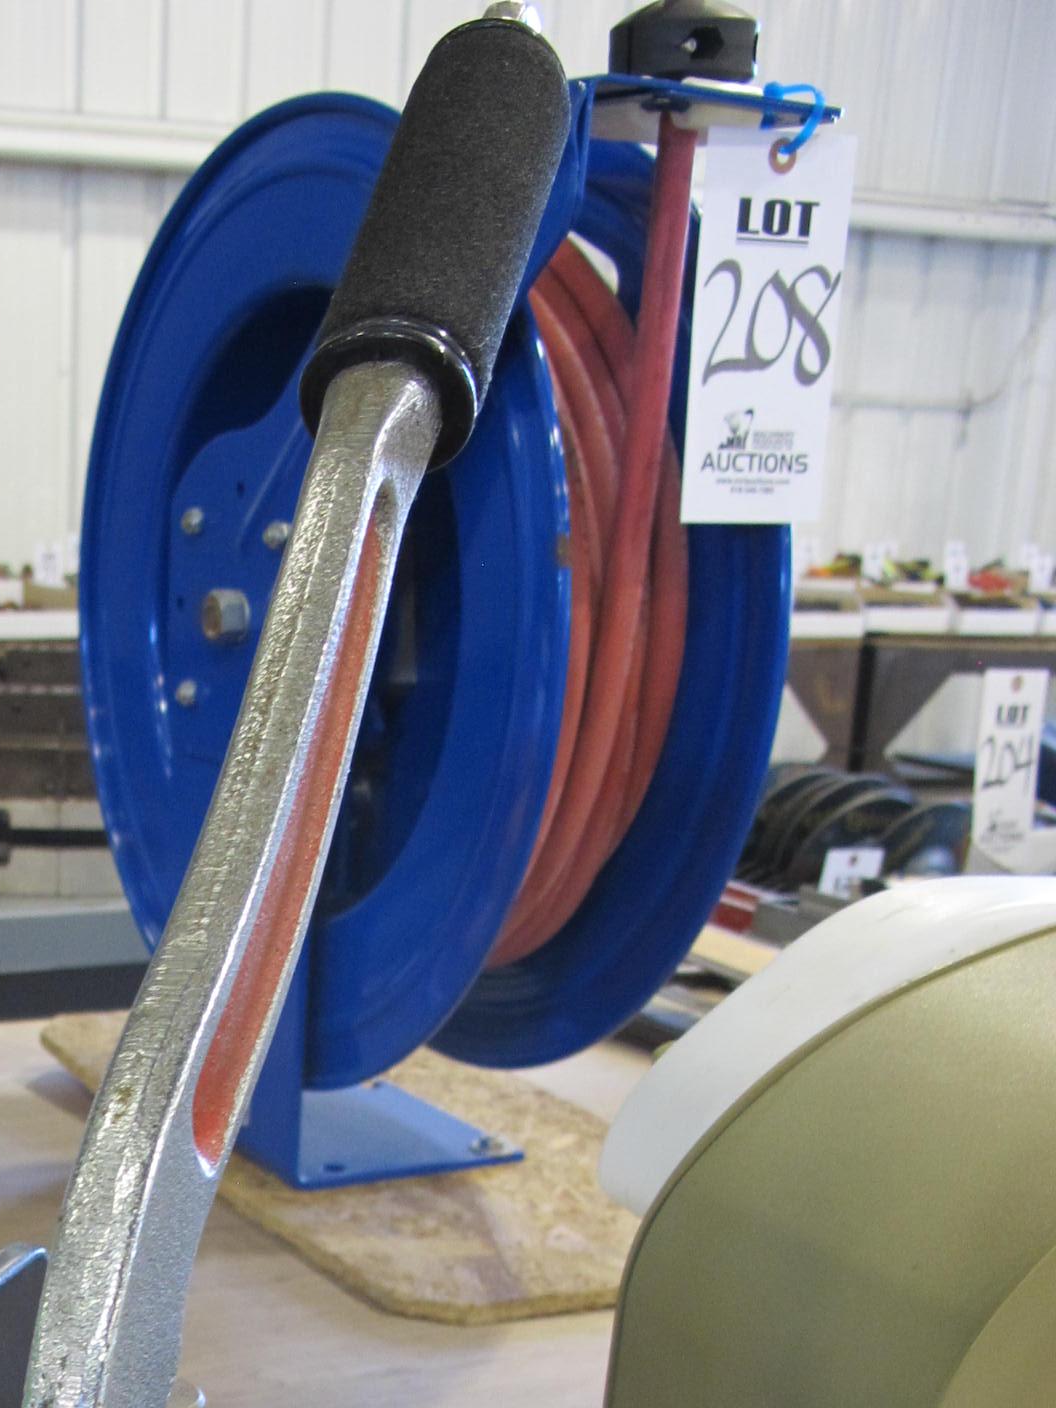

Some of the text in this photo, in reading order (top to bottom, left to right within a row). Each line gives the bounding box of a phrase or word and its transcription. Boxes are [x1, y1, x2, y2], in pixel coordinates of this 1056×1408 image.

[737, 197, 819, 239] LOT
[702, 259, 841, 386] 208
[701, 452, 808, 474] AUCTIONS
[997, 704, 1030, 725] LOT
